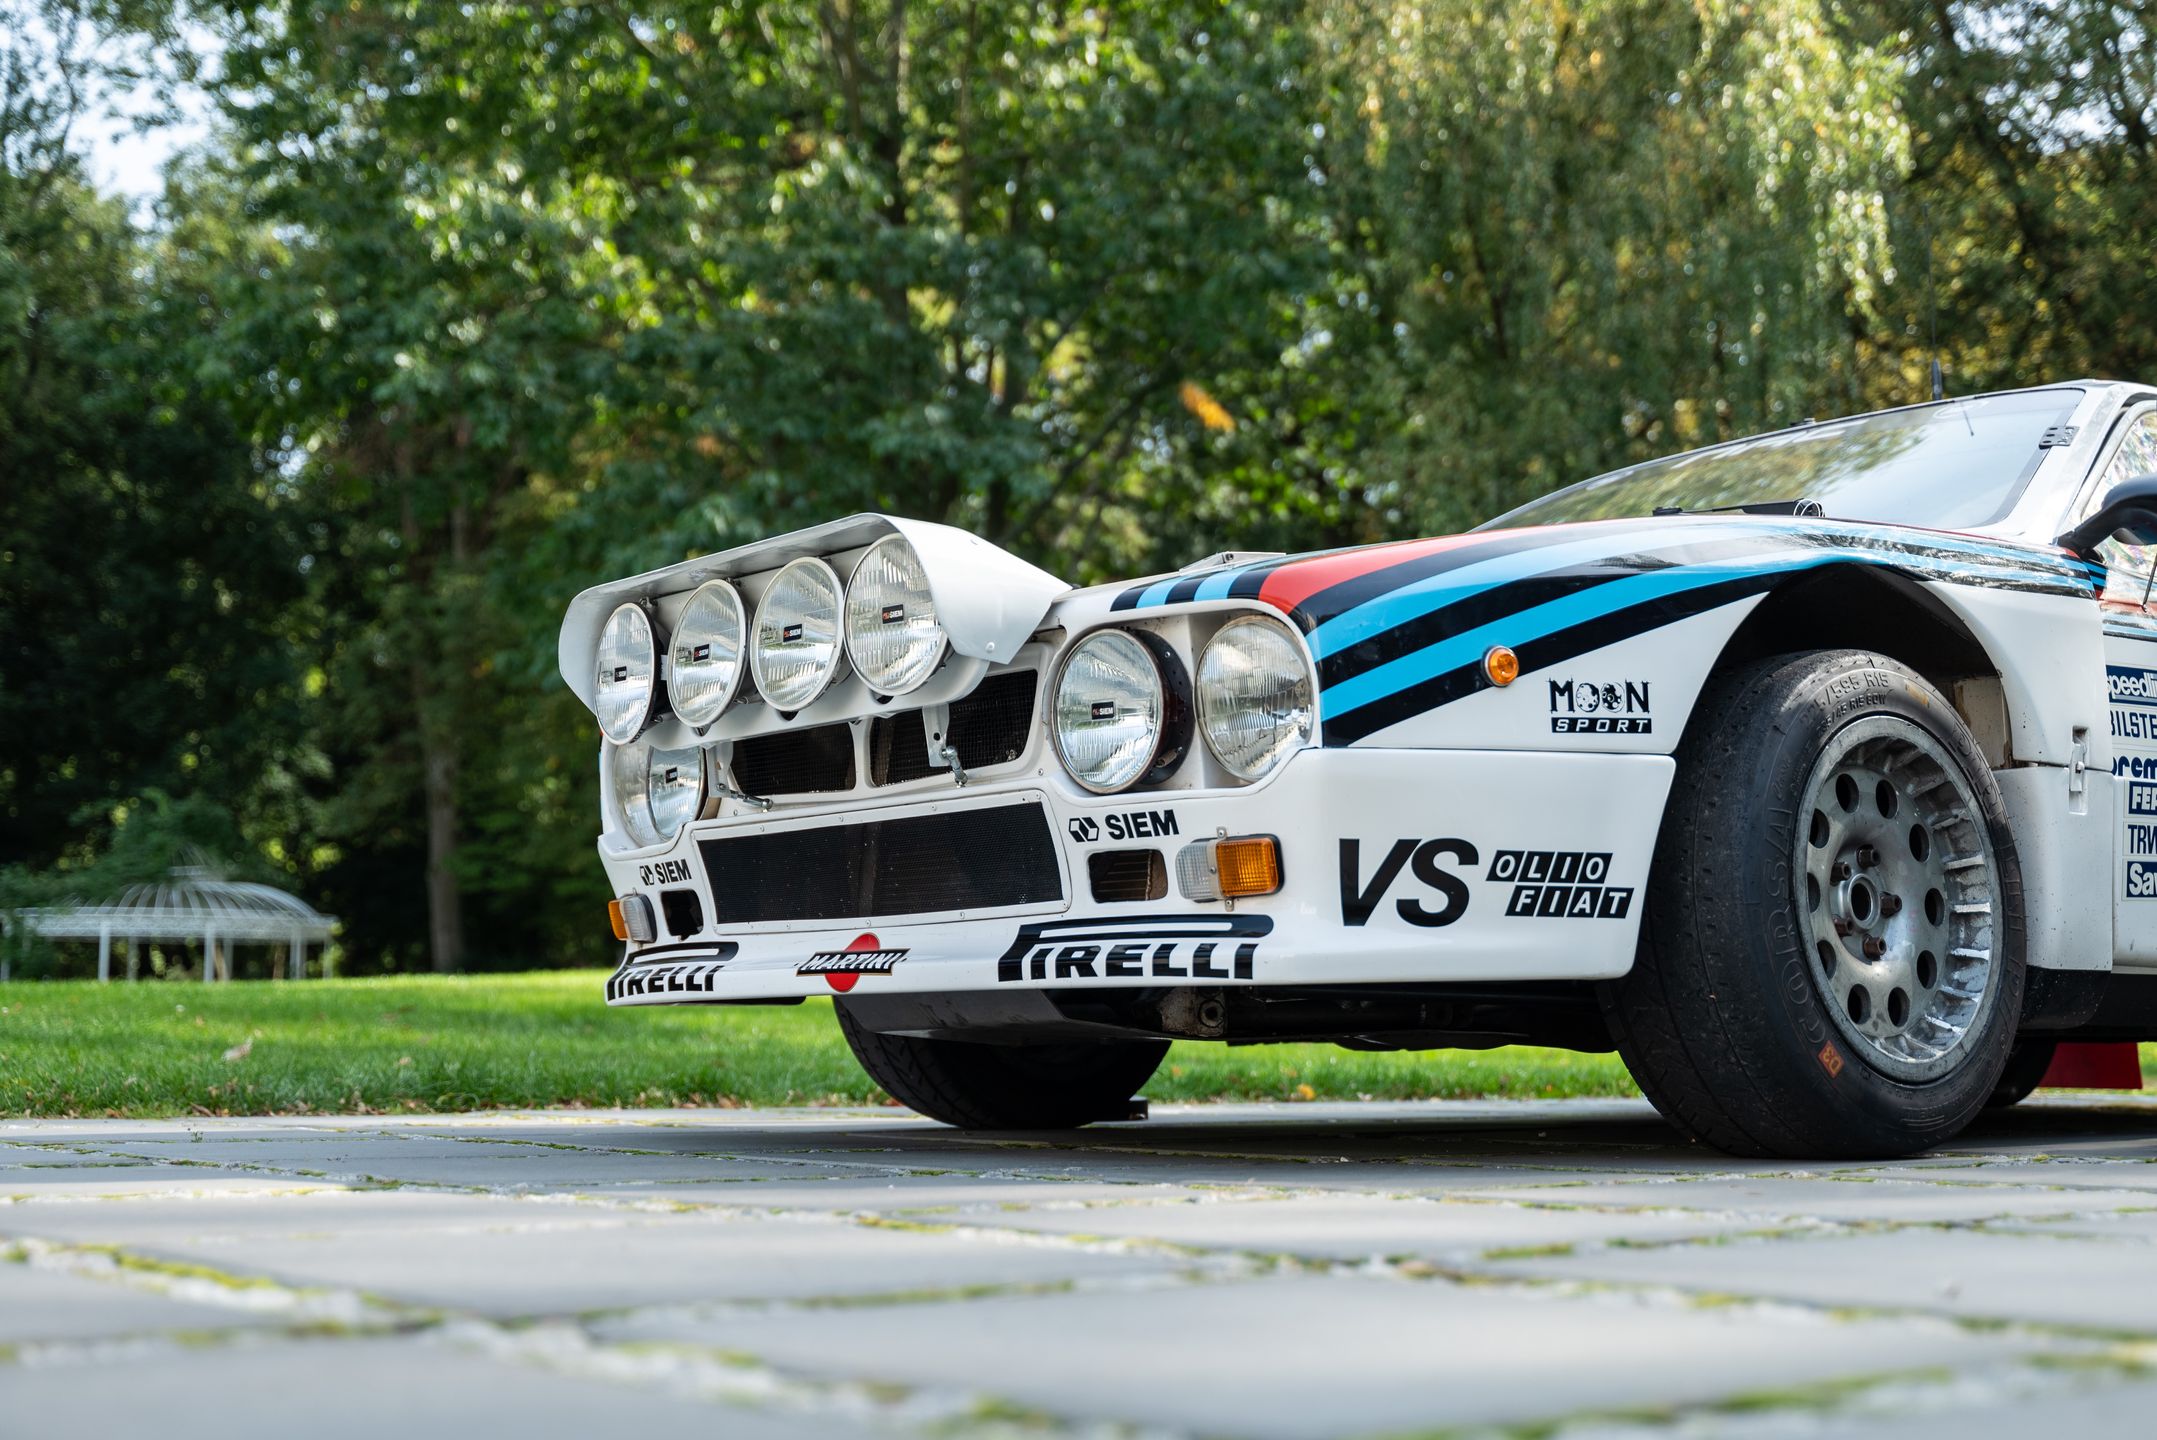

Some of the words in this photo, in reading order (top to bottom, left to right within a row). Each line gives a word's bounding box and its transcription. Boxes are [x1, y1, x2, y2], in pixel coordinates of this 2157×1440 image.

[889, 609, 903, 619] SIEM
[1548, 678, 1651, 714] MOON
[1099, 706, 1114, 716] SIEM
[1555, 718, 1649, 733] SPORT
[1105, 809, 1179, 841] SIEM
[655, 859, 692, 884] SIEM
[1495, 853, 1605, 881] OLIO
[1339, 837, 1479, 928] VS
[1514, 889, 1628, 915] FIAT
[799, 952, 903, 971] MARTINI
[998, 914, 1274, 982] PIRELLI
[607, 941, 739, 1002] PIRELLI
[1822, 1046, 1843, 1073] D3
